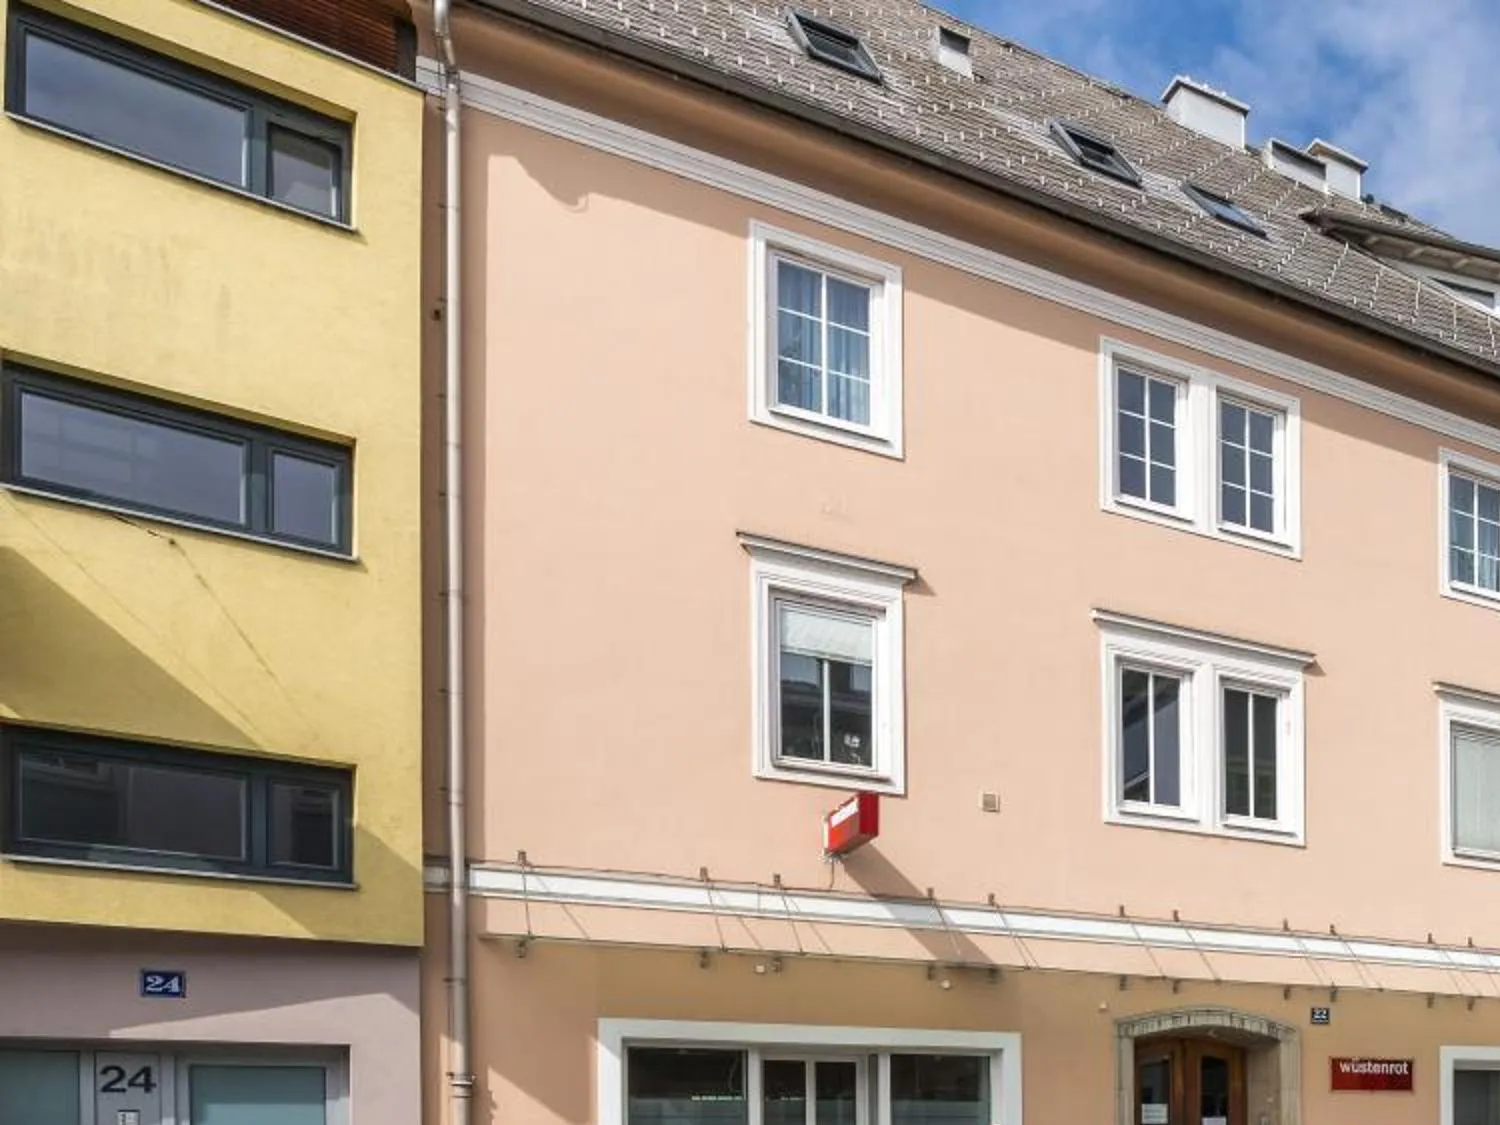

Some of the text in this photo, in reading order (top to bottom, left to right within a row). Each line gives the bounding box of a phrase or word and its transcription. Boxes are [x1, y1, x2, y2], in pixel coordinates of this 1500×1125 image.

[145, 975, 180, 993] 24
[1340, 1058, 1409, 1075] wüstenrot
[100, 1065, 157, 1094] 24
